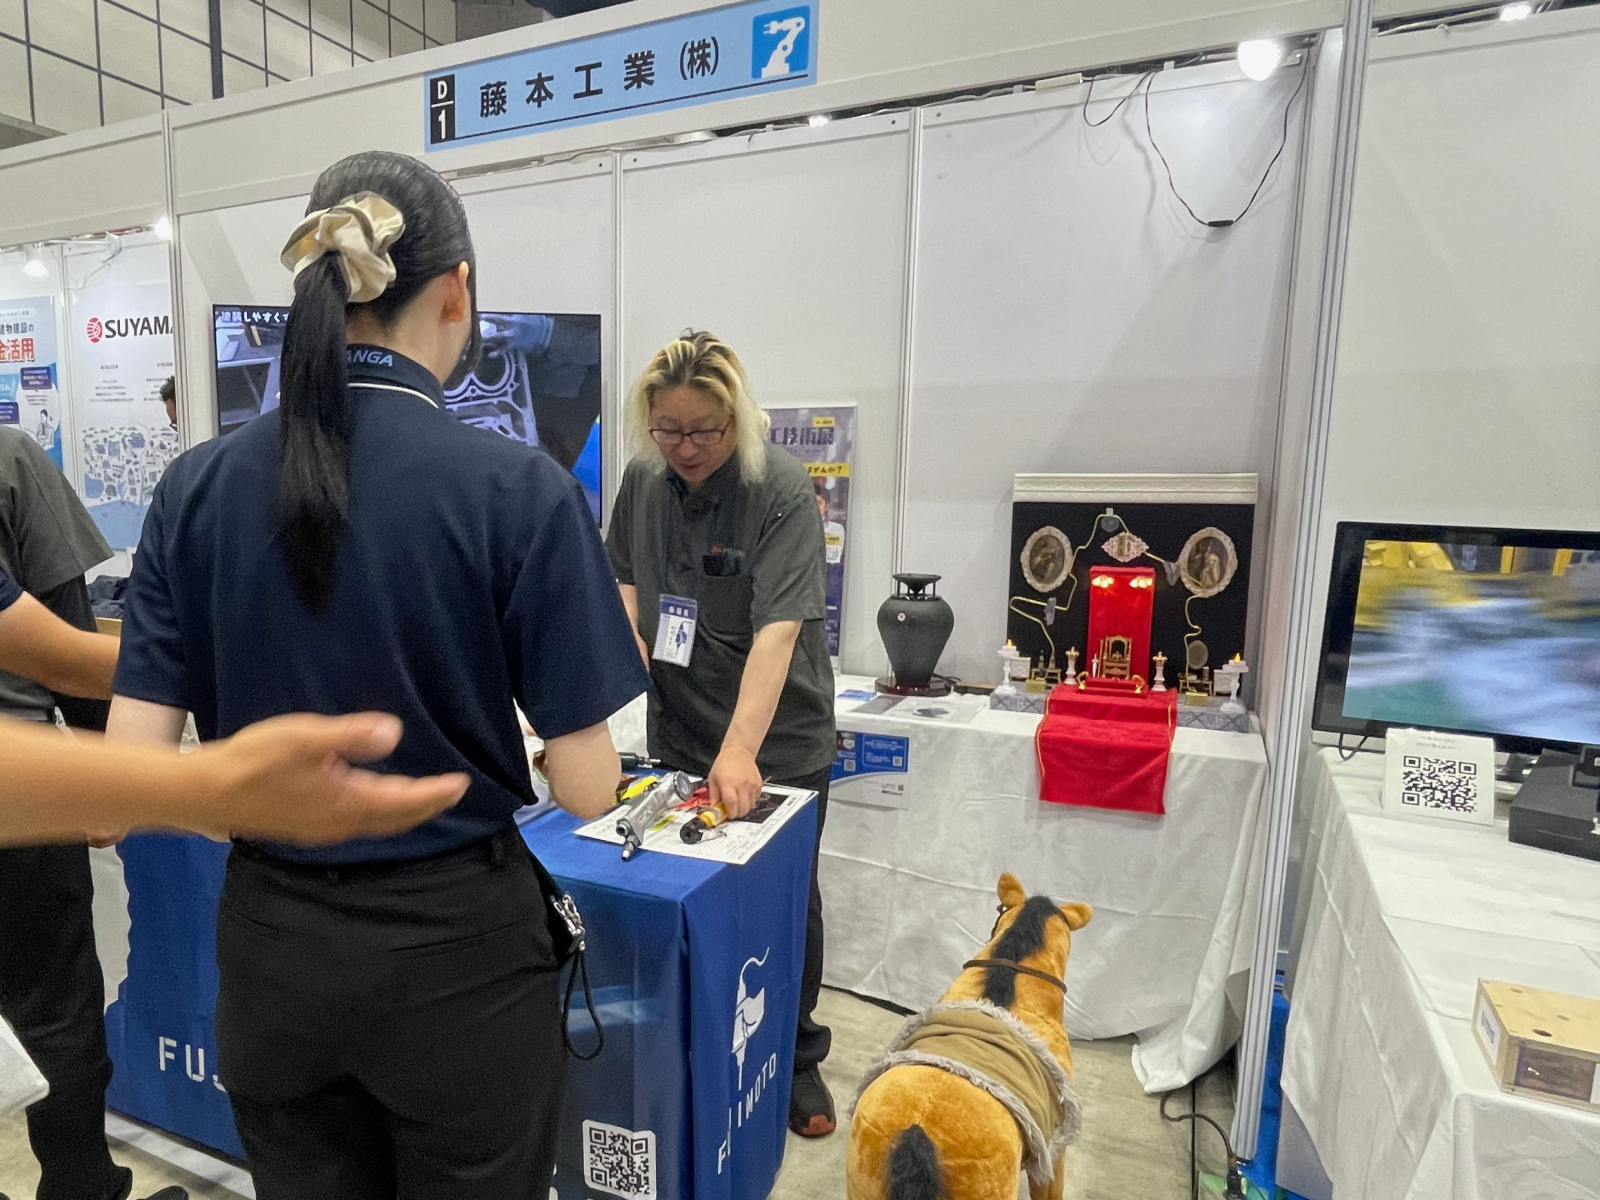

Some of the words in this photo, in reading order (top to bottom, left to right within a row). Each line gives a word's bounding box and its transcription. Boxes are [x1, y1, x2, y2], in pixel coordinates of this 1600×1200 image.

[437, 80, 448, 100] D
[480, 36, 719, 118] 藤本工業(株)
[438, 109, 446, 139] 1
[104, 315, 173, 338] SUYAM
[717, 1052, 777, 1175] FIMOTO
